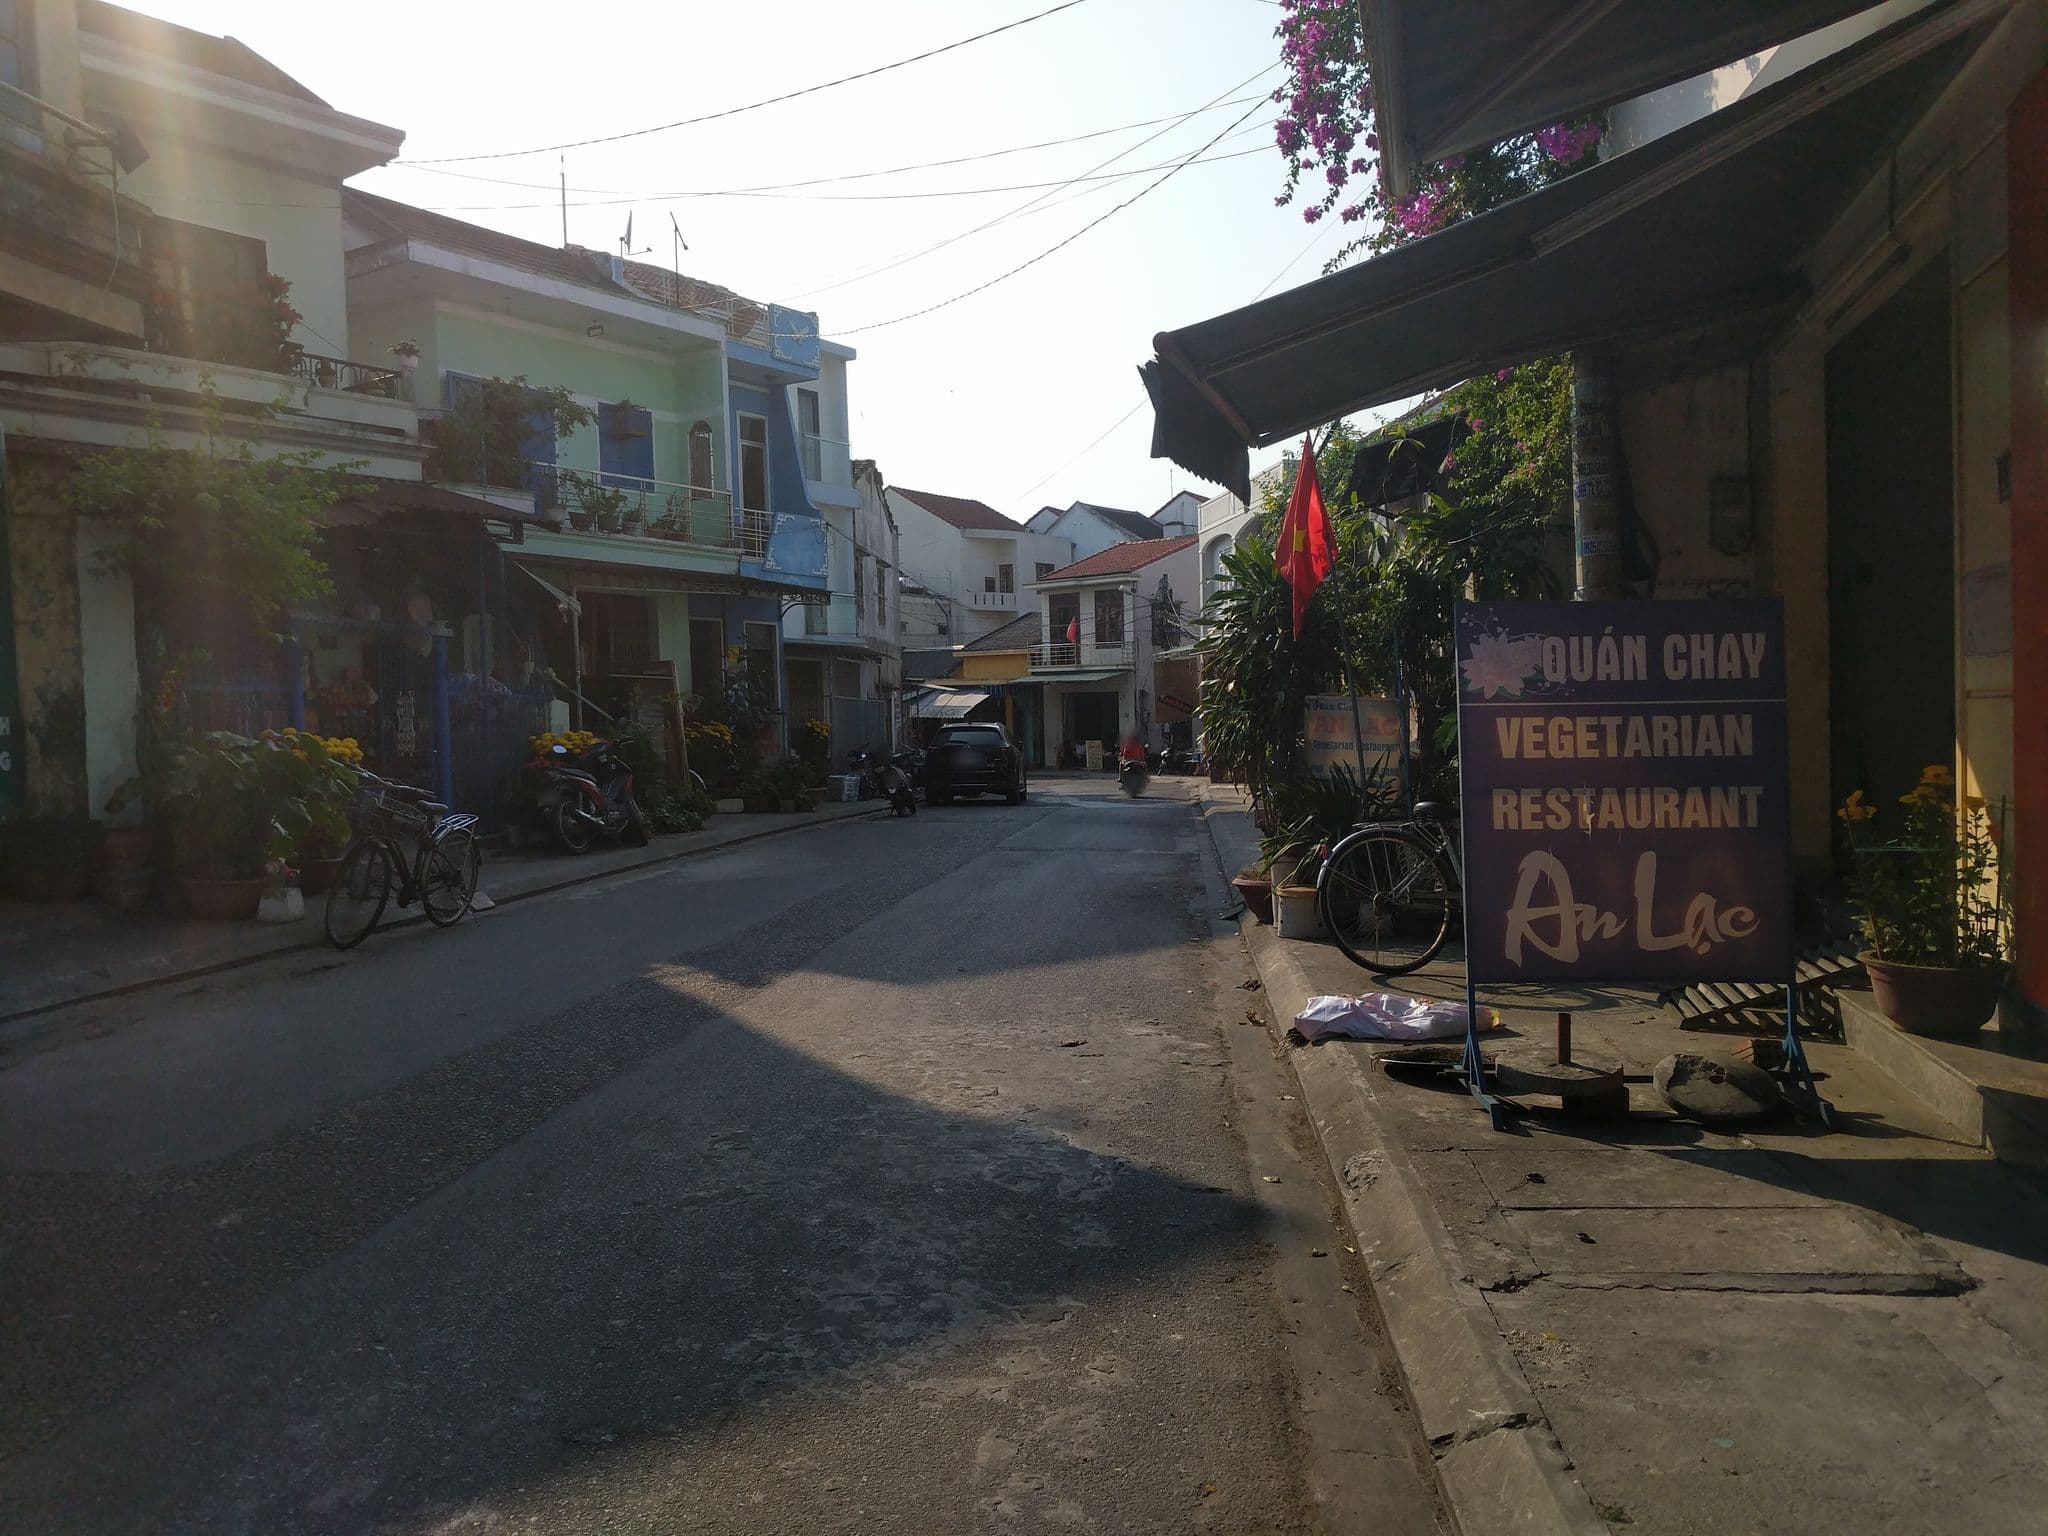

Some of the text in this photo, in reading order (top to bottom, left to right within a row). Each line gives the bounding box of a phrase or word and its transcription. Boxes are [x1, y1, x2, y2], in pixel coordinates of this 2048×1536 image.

[1542, 626, 1766, 682] QUÁN CHAY
[1496, 714, 1753, 759] VEGETARIAN
[1492, 785, 1764, 831] RESTAURANT
[1504, 848, 1760, 968] An Lạc
